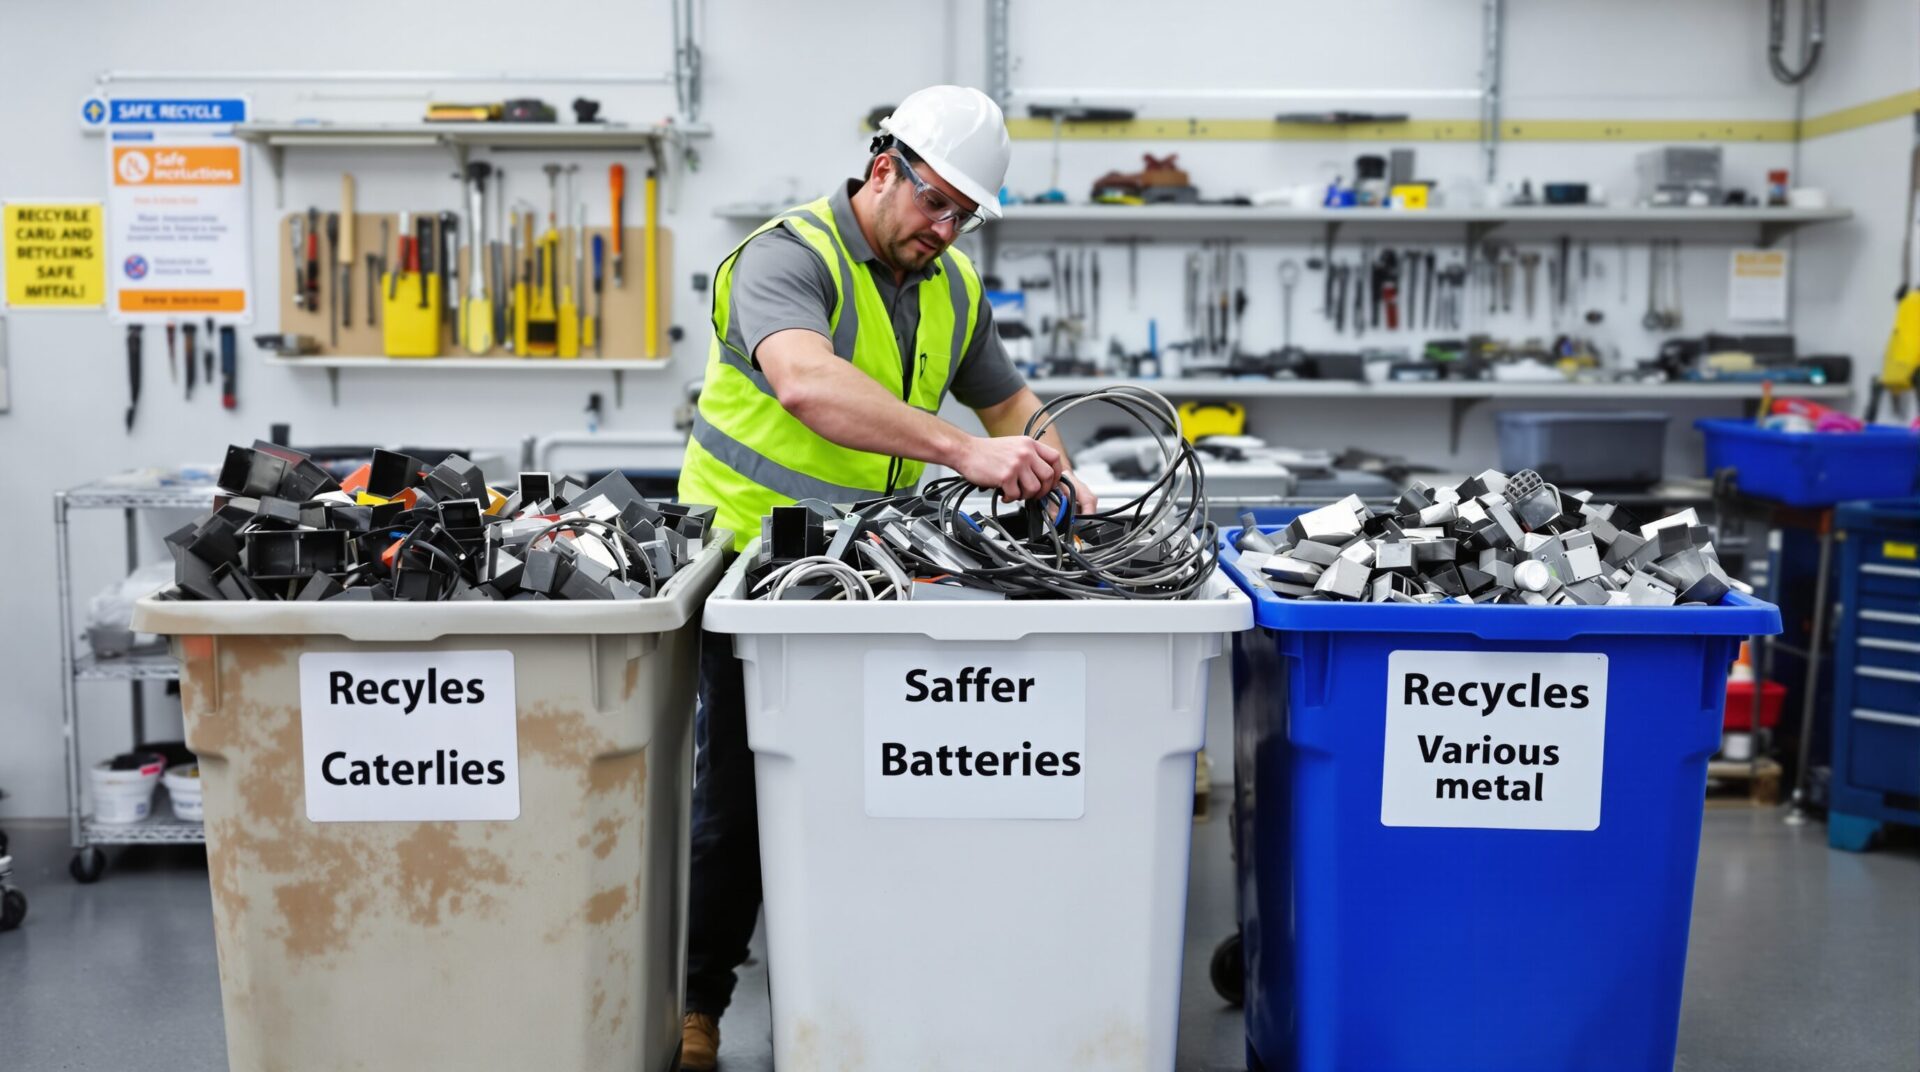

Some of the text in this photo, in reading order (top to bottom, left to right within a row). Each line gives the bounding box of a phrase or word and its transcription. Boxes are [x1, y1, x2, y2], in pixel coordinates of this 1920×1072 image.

[159, 104, 222, 119] RECYCLE
[154, 152, 187, 166] Safe
[61, 227, 93, 241] AND
[37, 265, 74, 280] SAFE
[330, 668, 484, 714] Recyles
[906, 667, 1034, 702] Saffer
[1405, 673, 1589, 716] Recycles
[883, 741, 1080, 776] Batteries
[1418, 735, 1559, 765] Various
[322, 750, 505, 785] Caterlies
[1436, 773, 1543, 801] metal
